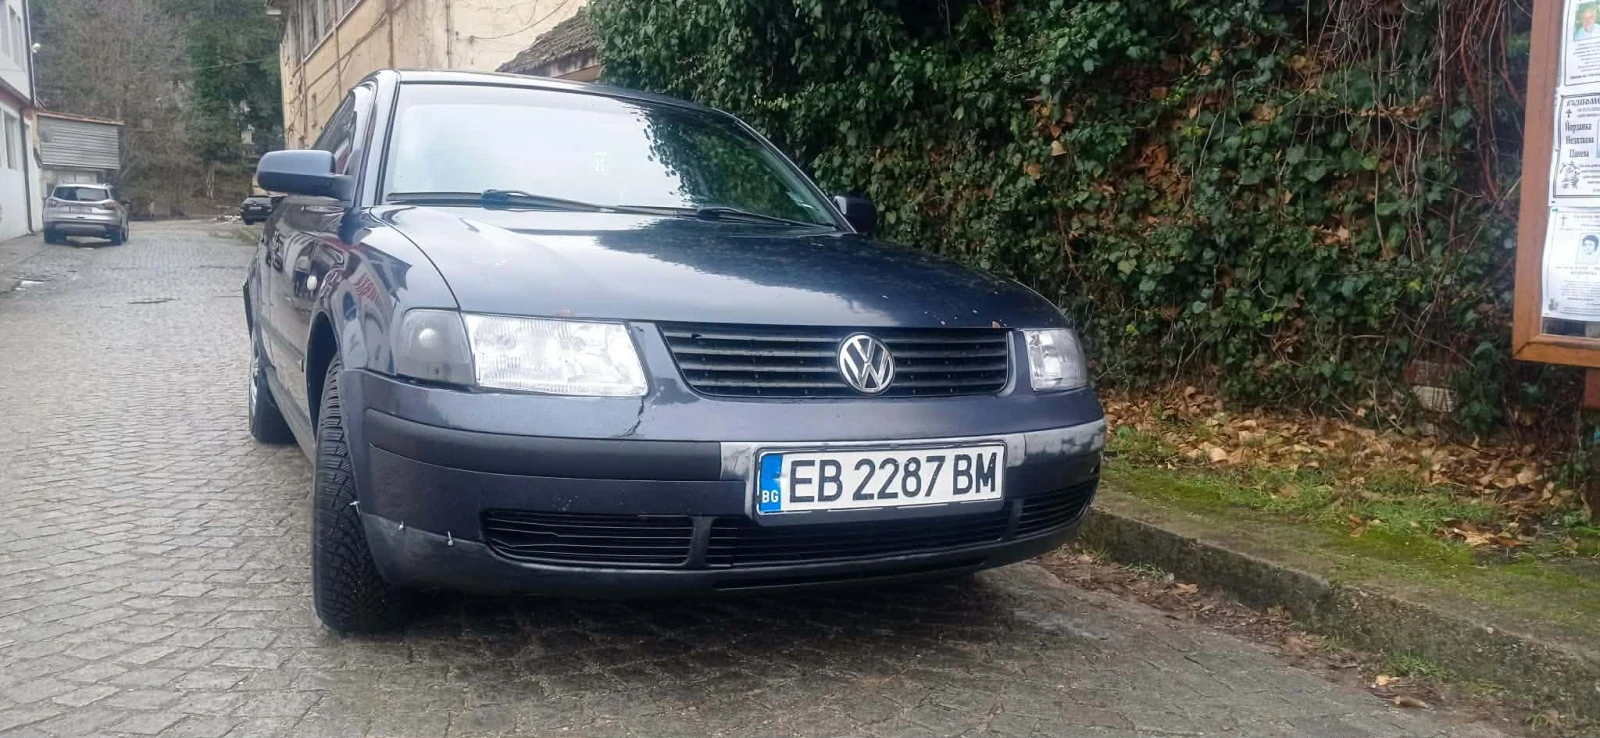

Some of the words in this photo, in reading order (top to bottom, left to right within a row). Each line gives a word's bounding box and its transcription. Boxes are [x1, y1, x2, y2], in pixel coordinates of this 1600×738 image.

[839, 334, 894, 393] VW
[762, 491, 779, 503] BG
[789, 459, 843, 503] EB
[852, 455, 946, 501] 2287
[952, 452, 997, 496] BM
